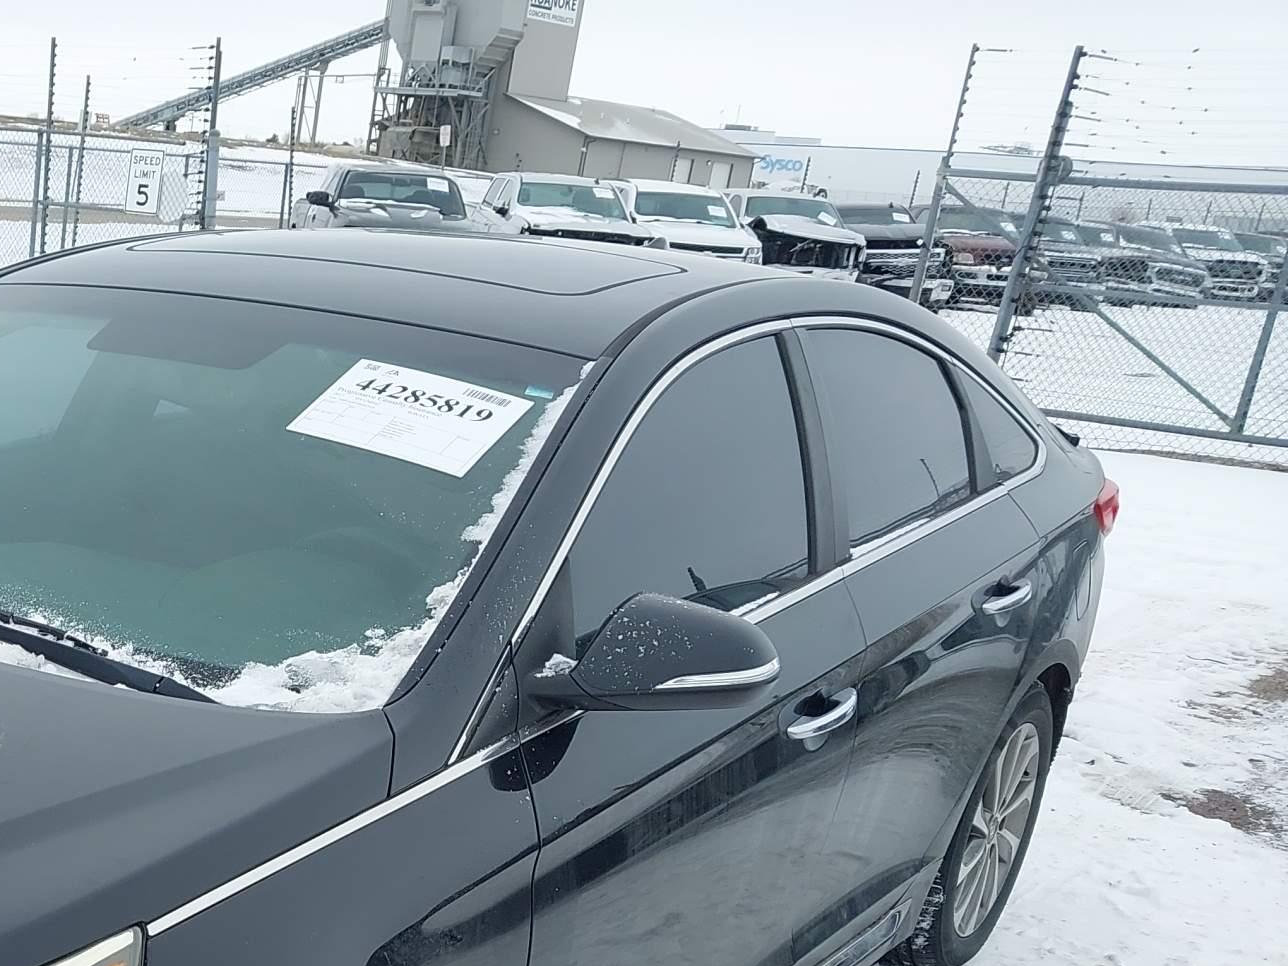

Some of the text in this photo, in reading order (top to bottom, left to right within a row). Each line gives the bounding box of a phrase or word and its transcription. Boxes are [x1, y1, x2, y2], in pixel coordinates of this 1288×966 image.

[530, 0, 576, 11] ANOKE
[528, 8, 574, 25] CONCRETE PRODUCTS
[133, 155, 160, 165] SPEED
[760, 154, 803, 174] Sysco
[134, 169, 156, 179] LIMIT
[136, 184, 149, 206] 5
[355, 378, 493, 422] 44285819
